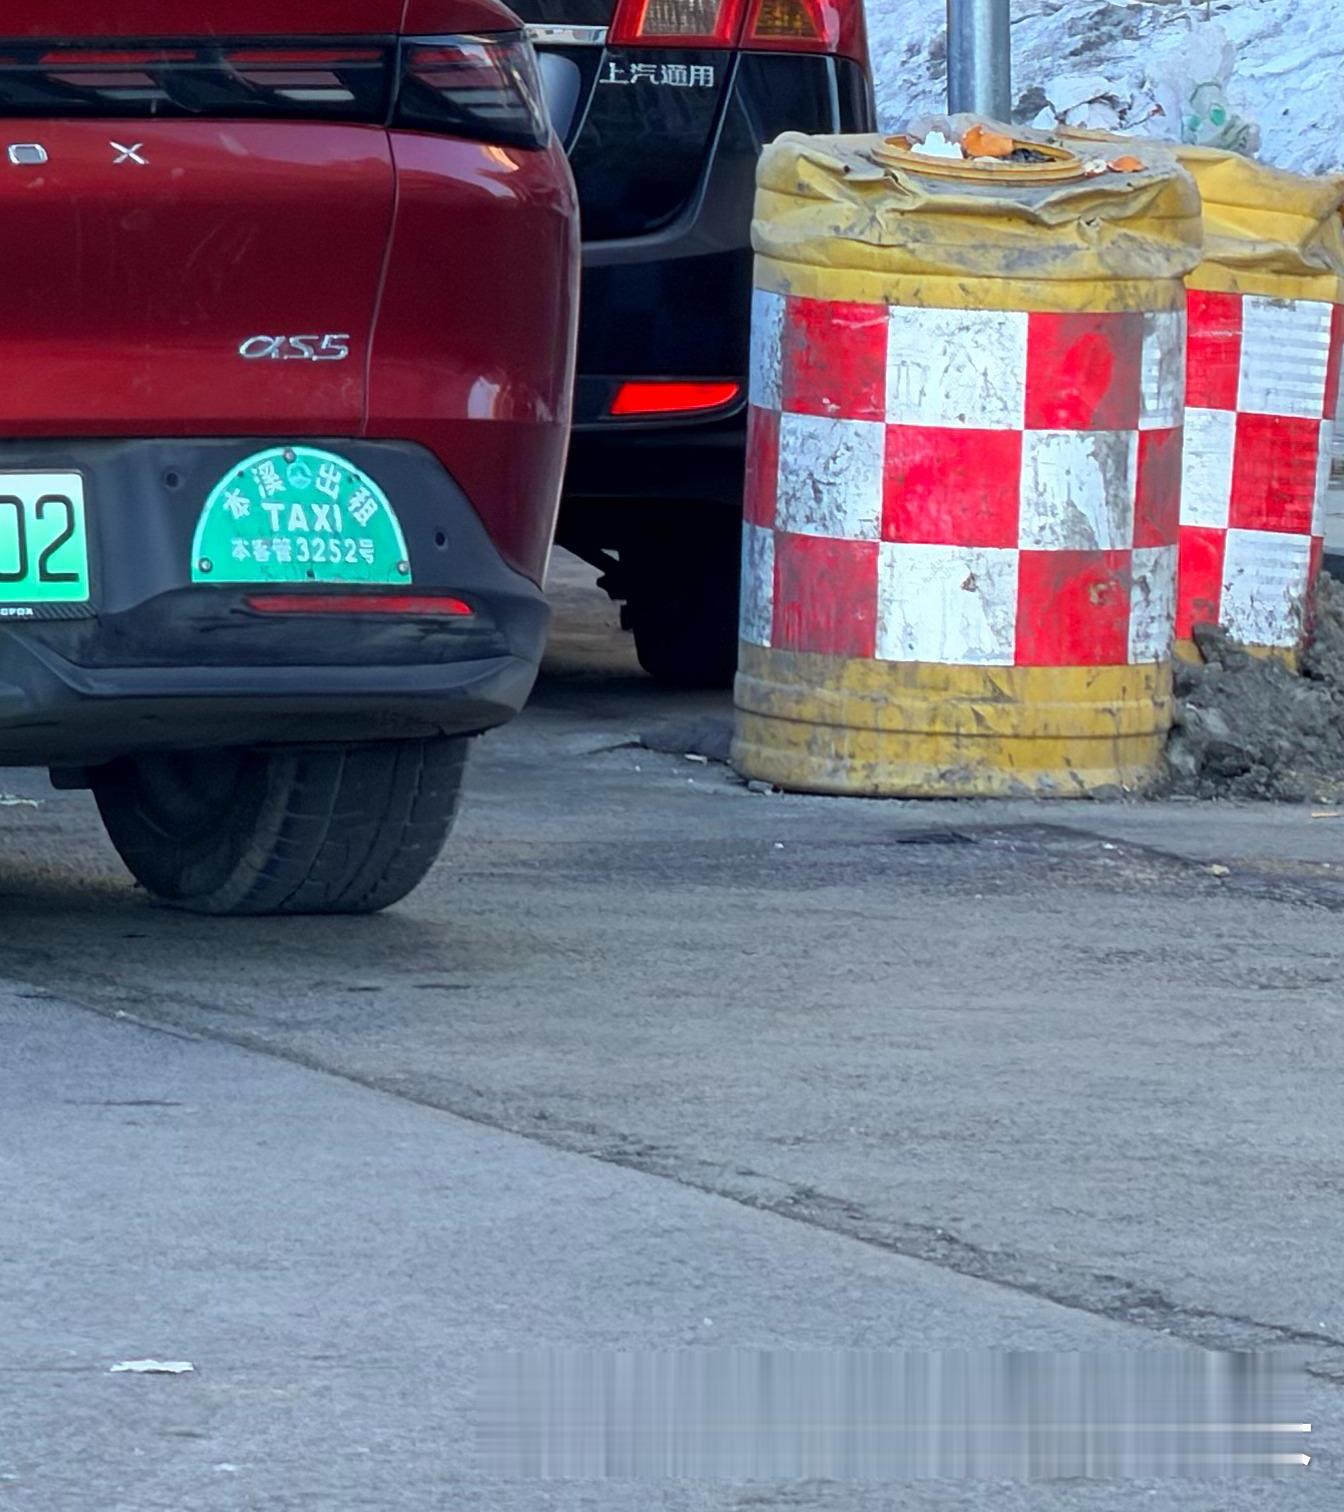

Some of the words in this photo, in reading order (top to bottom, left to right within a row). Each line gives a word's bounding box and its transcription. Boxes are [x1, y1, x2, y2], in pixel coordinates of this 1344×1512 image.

[599, 61, 716, 88] 上汽通用
[261, 502, 343, 534] TAXI
